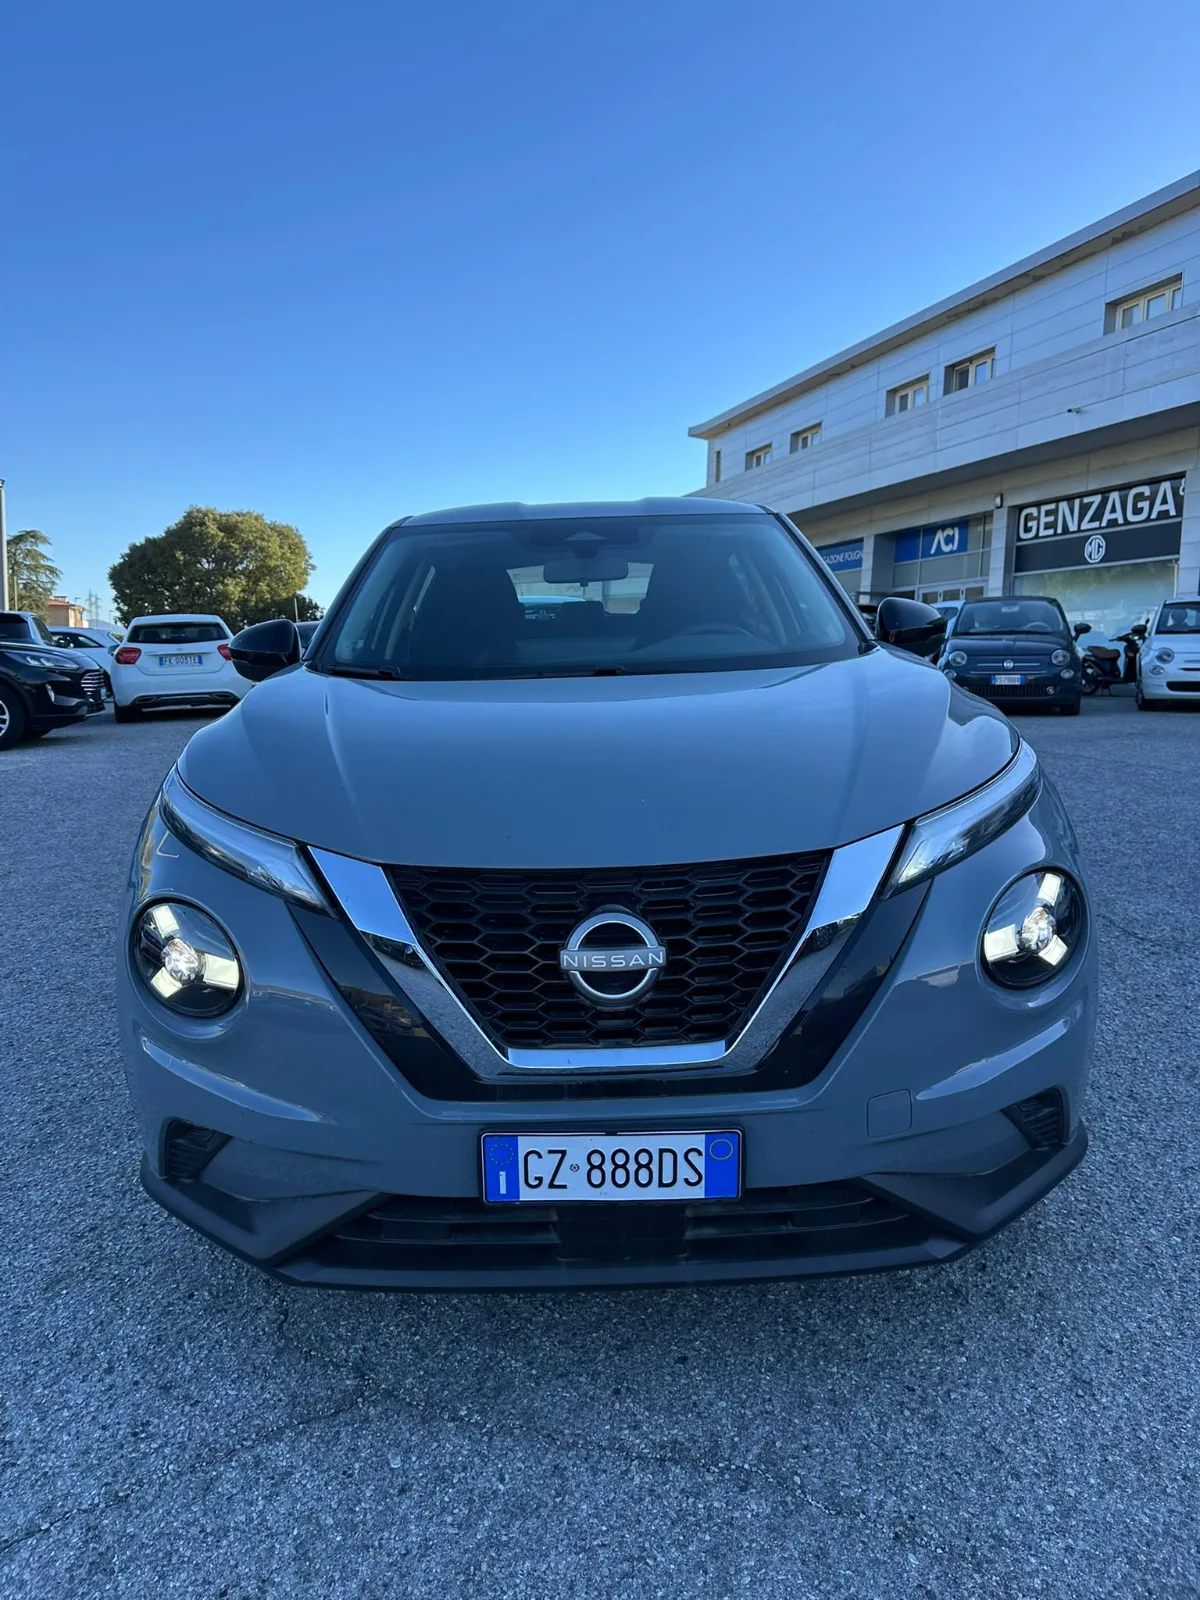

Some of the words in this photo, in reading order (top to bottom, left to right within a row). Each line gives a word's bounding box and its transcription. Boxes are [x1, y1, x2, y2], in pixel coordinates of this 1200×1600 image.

[1019, 481, 1176, 540] GENZAGA
[930, 527, 959, 555] ACI
[1086, 536, 1104, 562] MG
[563, 951, 664, 968] NISSAN
[523, 1149, 567, 1189] GZ
[586, 1147, 703, 1188] 888DS
